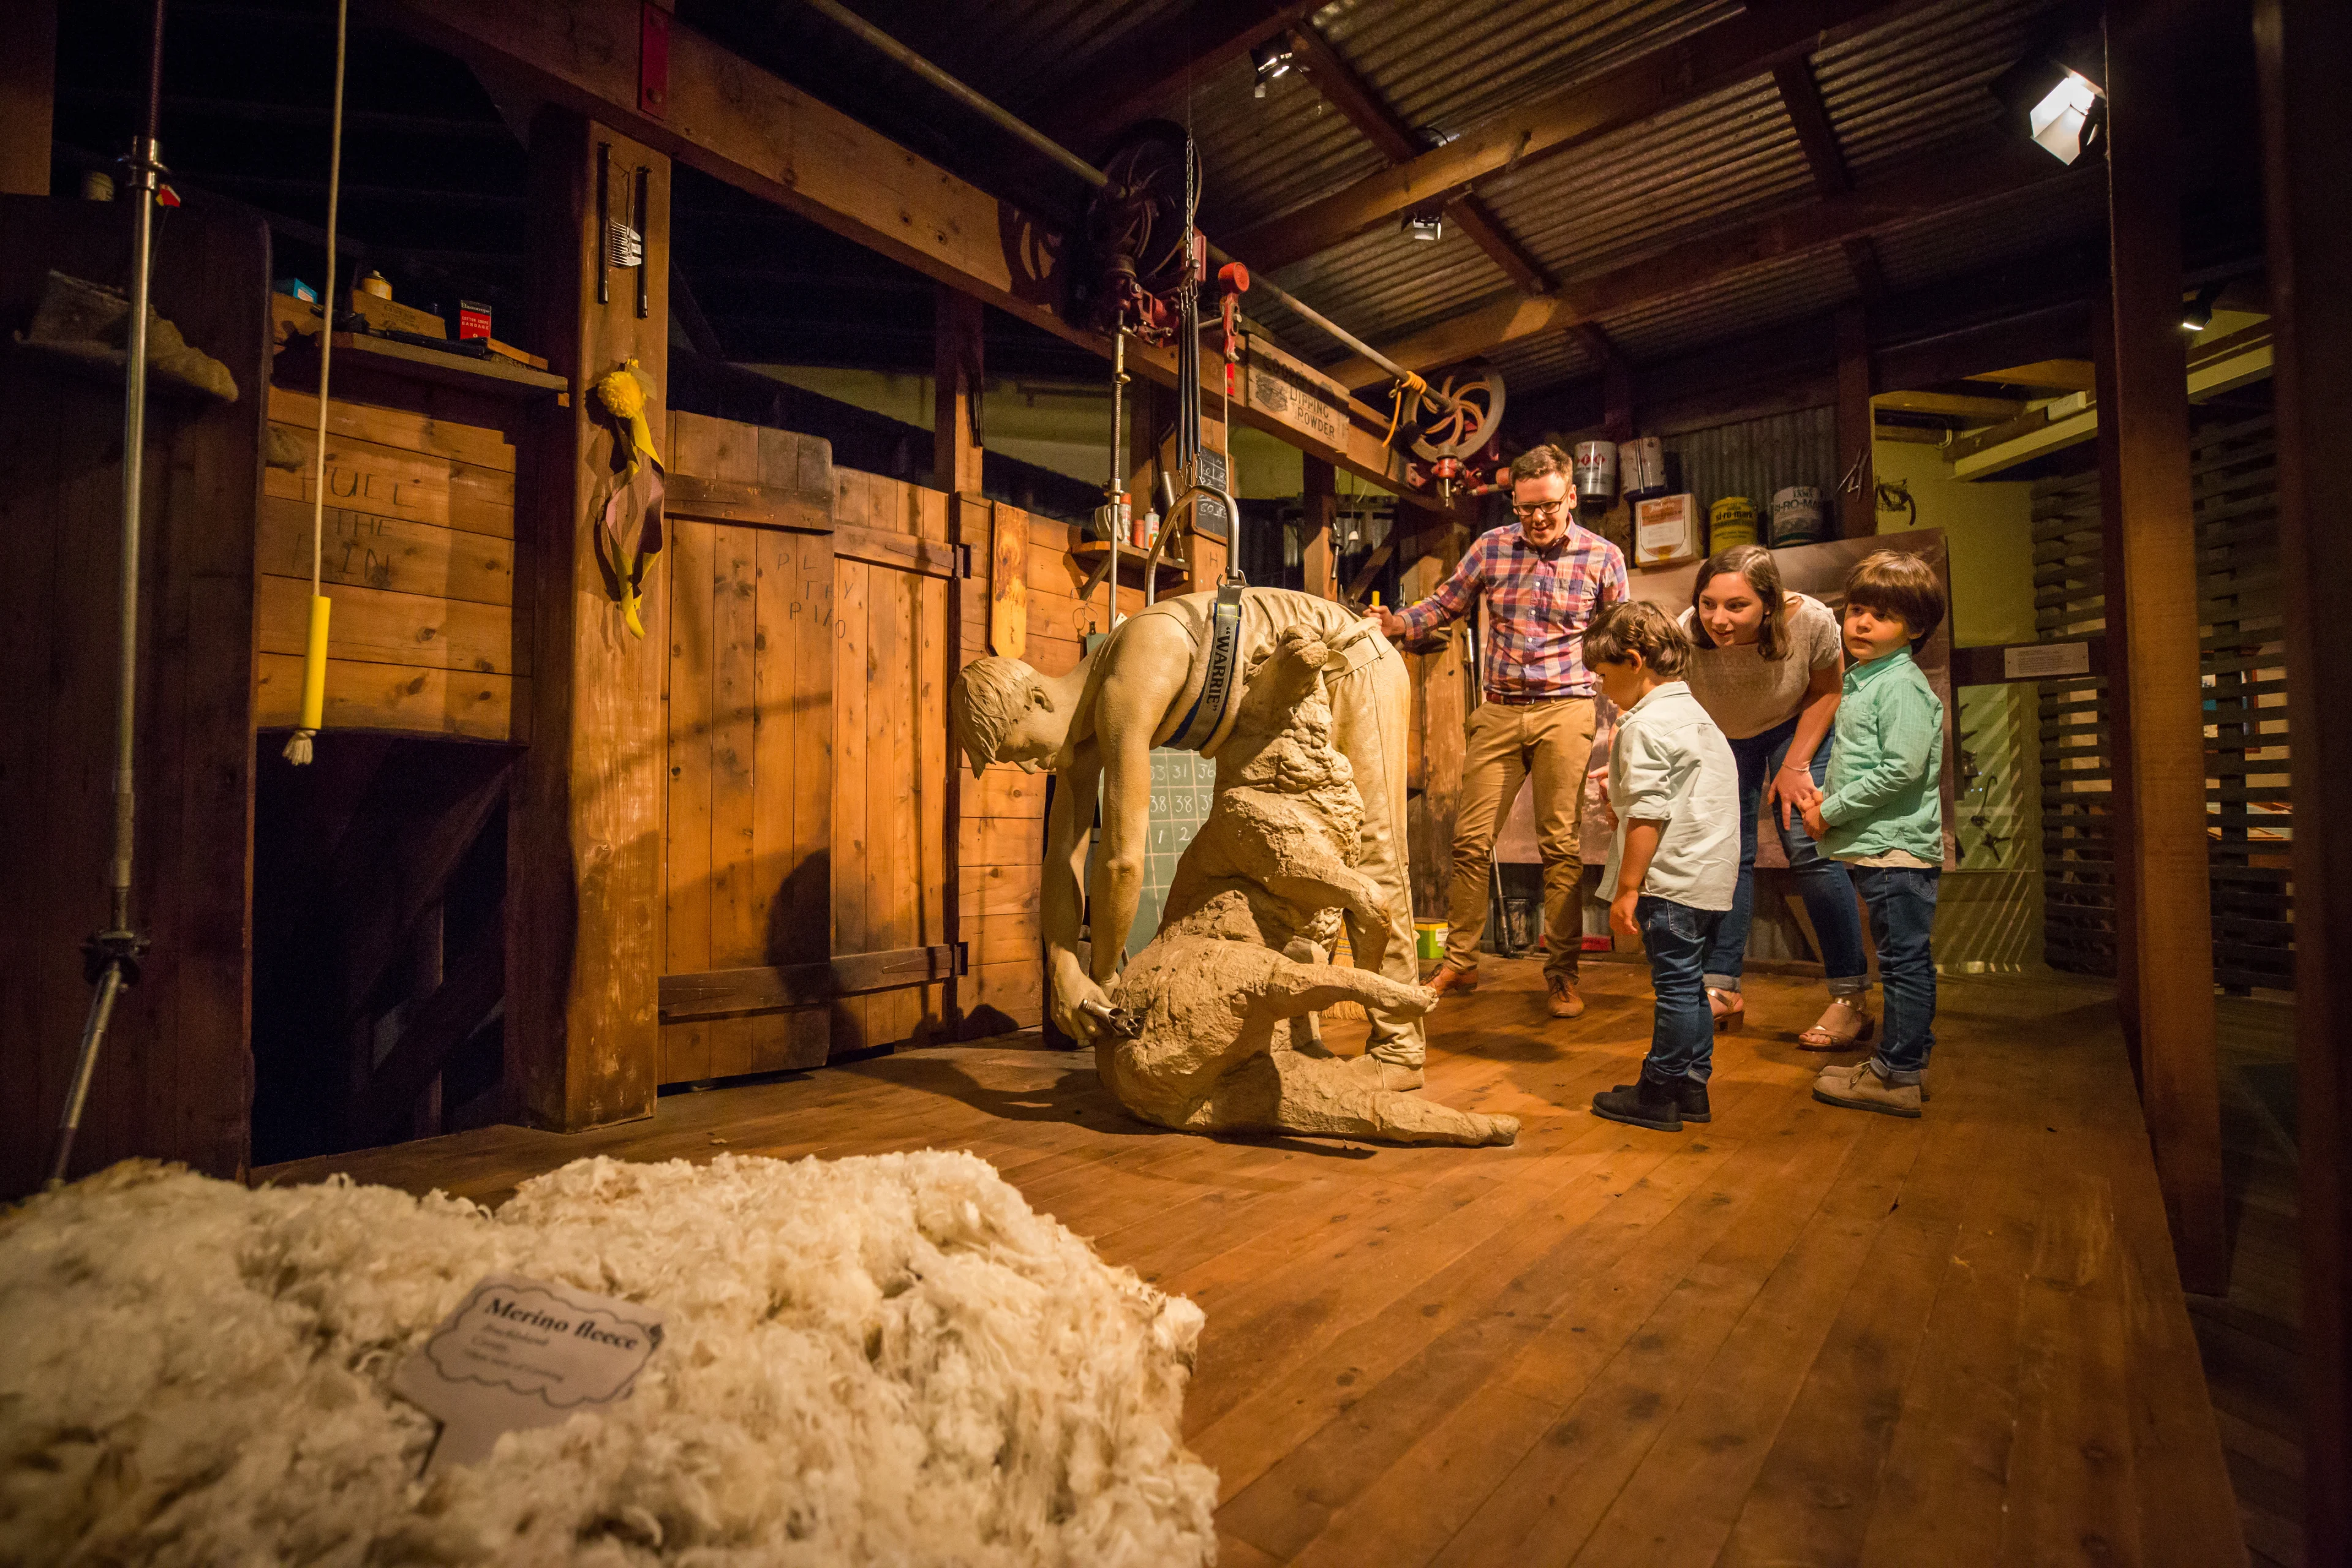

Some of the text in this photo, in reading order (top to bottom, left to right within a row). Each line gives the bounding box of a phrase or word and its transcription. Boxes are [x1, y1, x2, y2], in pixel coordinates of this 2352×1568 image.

[462, 321, 489, 330] BANDAGE
[1290, 386, 1330, 419] DIPPING
[1297, 406, 1335, 440] POWDER
[336, 510, 397, 537] THE
[1172, 763, 1187, 779] 31
[1197, 761, 1216, 779] 36
[1150, 795, 1167, 813] 38
[1175, 795, 1193, 813] 38
[1158, 826, 1191, 844] 1 2
[484, 1297, 569, 1333] Merino
[574, 1319, 638, 1351] fleece
